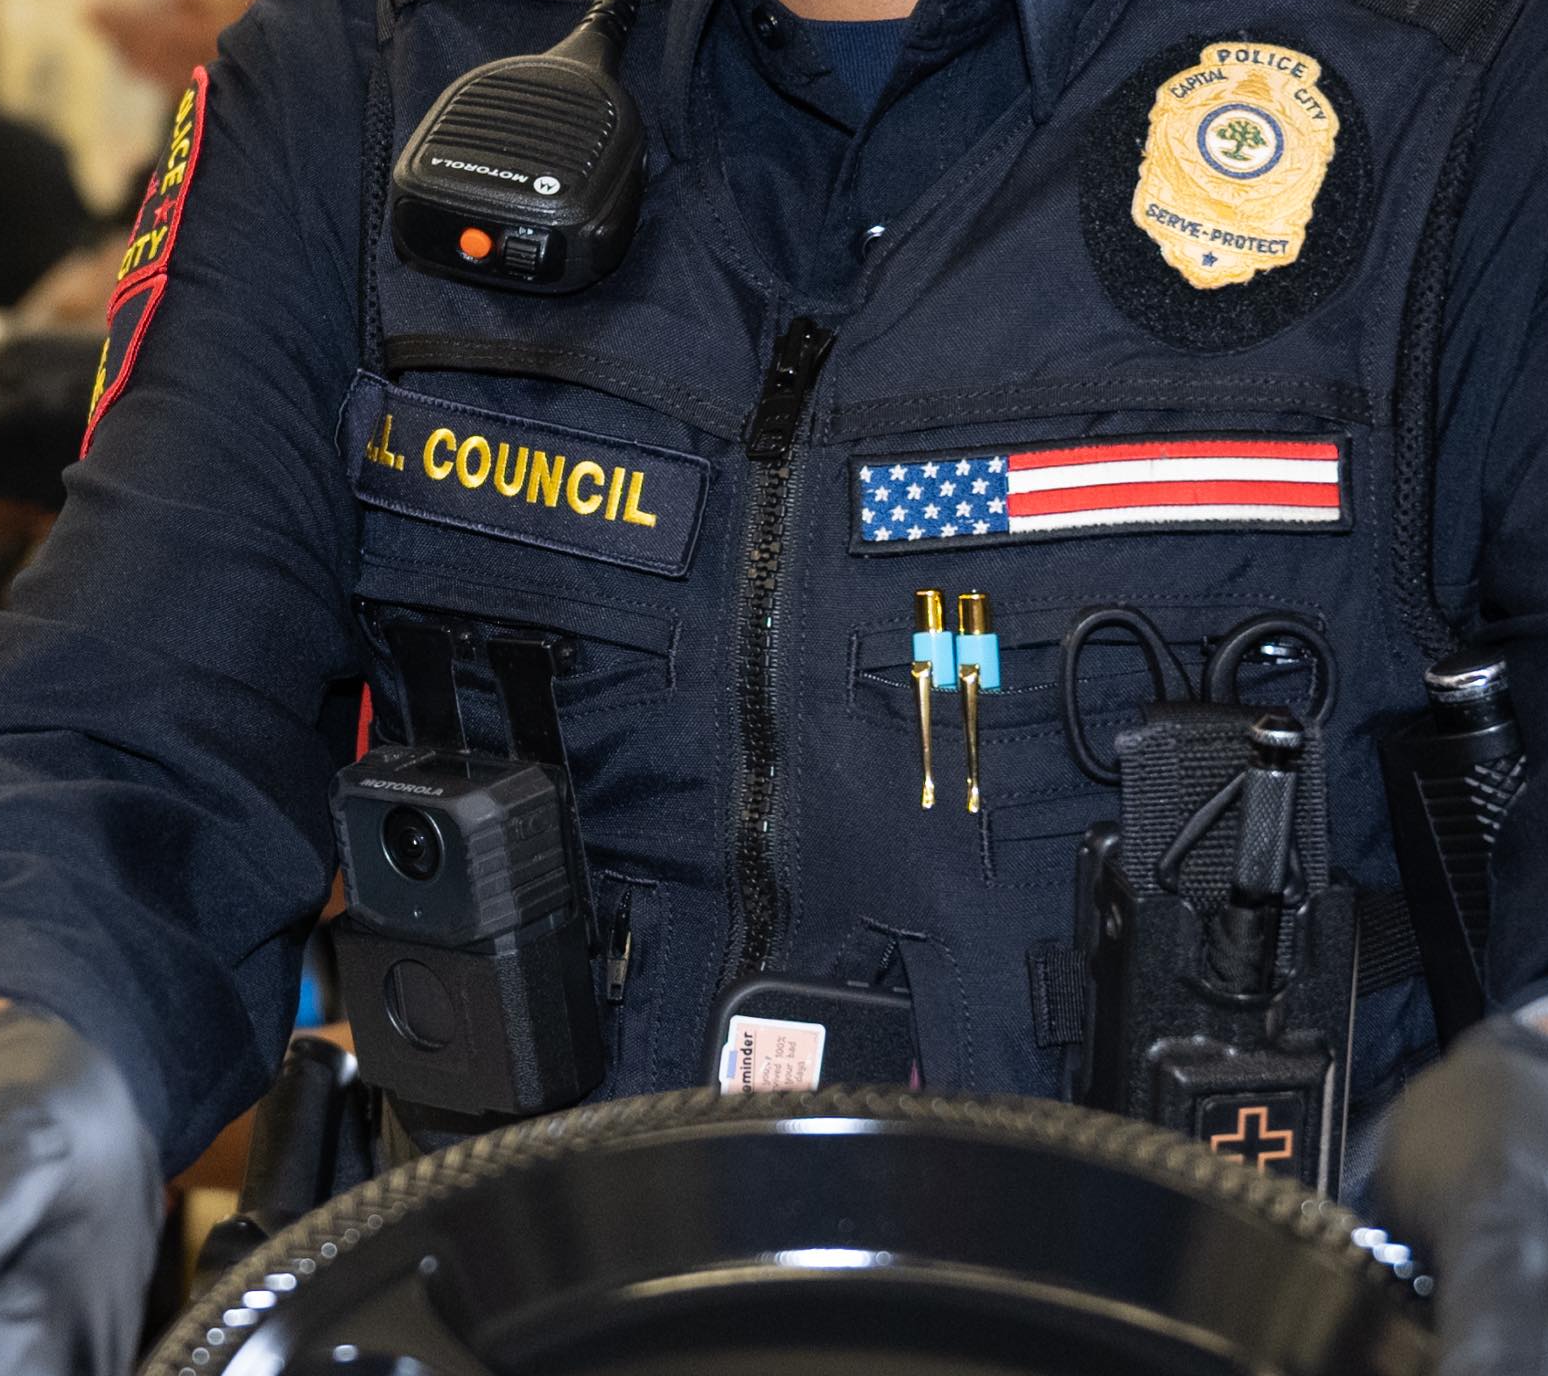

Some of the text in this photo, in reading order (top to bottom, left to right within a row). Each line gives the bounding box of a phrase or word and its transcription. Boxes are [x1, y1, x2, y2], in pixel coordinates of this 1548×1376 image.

[1216, 48, 1309, 79] POLICE
[1170, 68, 1327, 122] CAPITAL CITY
[160, 88, 195, 195] OLICE
[431, 157, 529, 183] MOTOROLA
[1145, 203, 1290, 255] SERVE-PROTECT
[423, 427, 656, 528] COUNCIL
[360, 778, 444, 796] MOTOROLA
[740, 1032, 753, 1093] eminder
